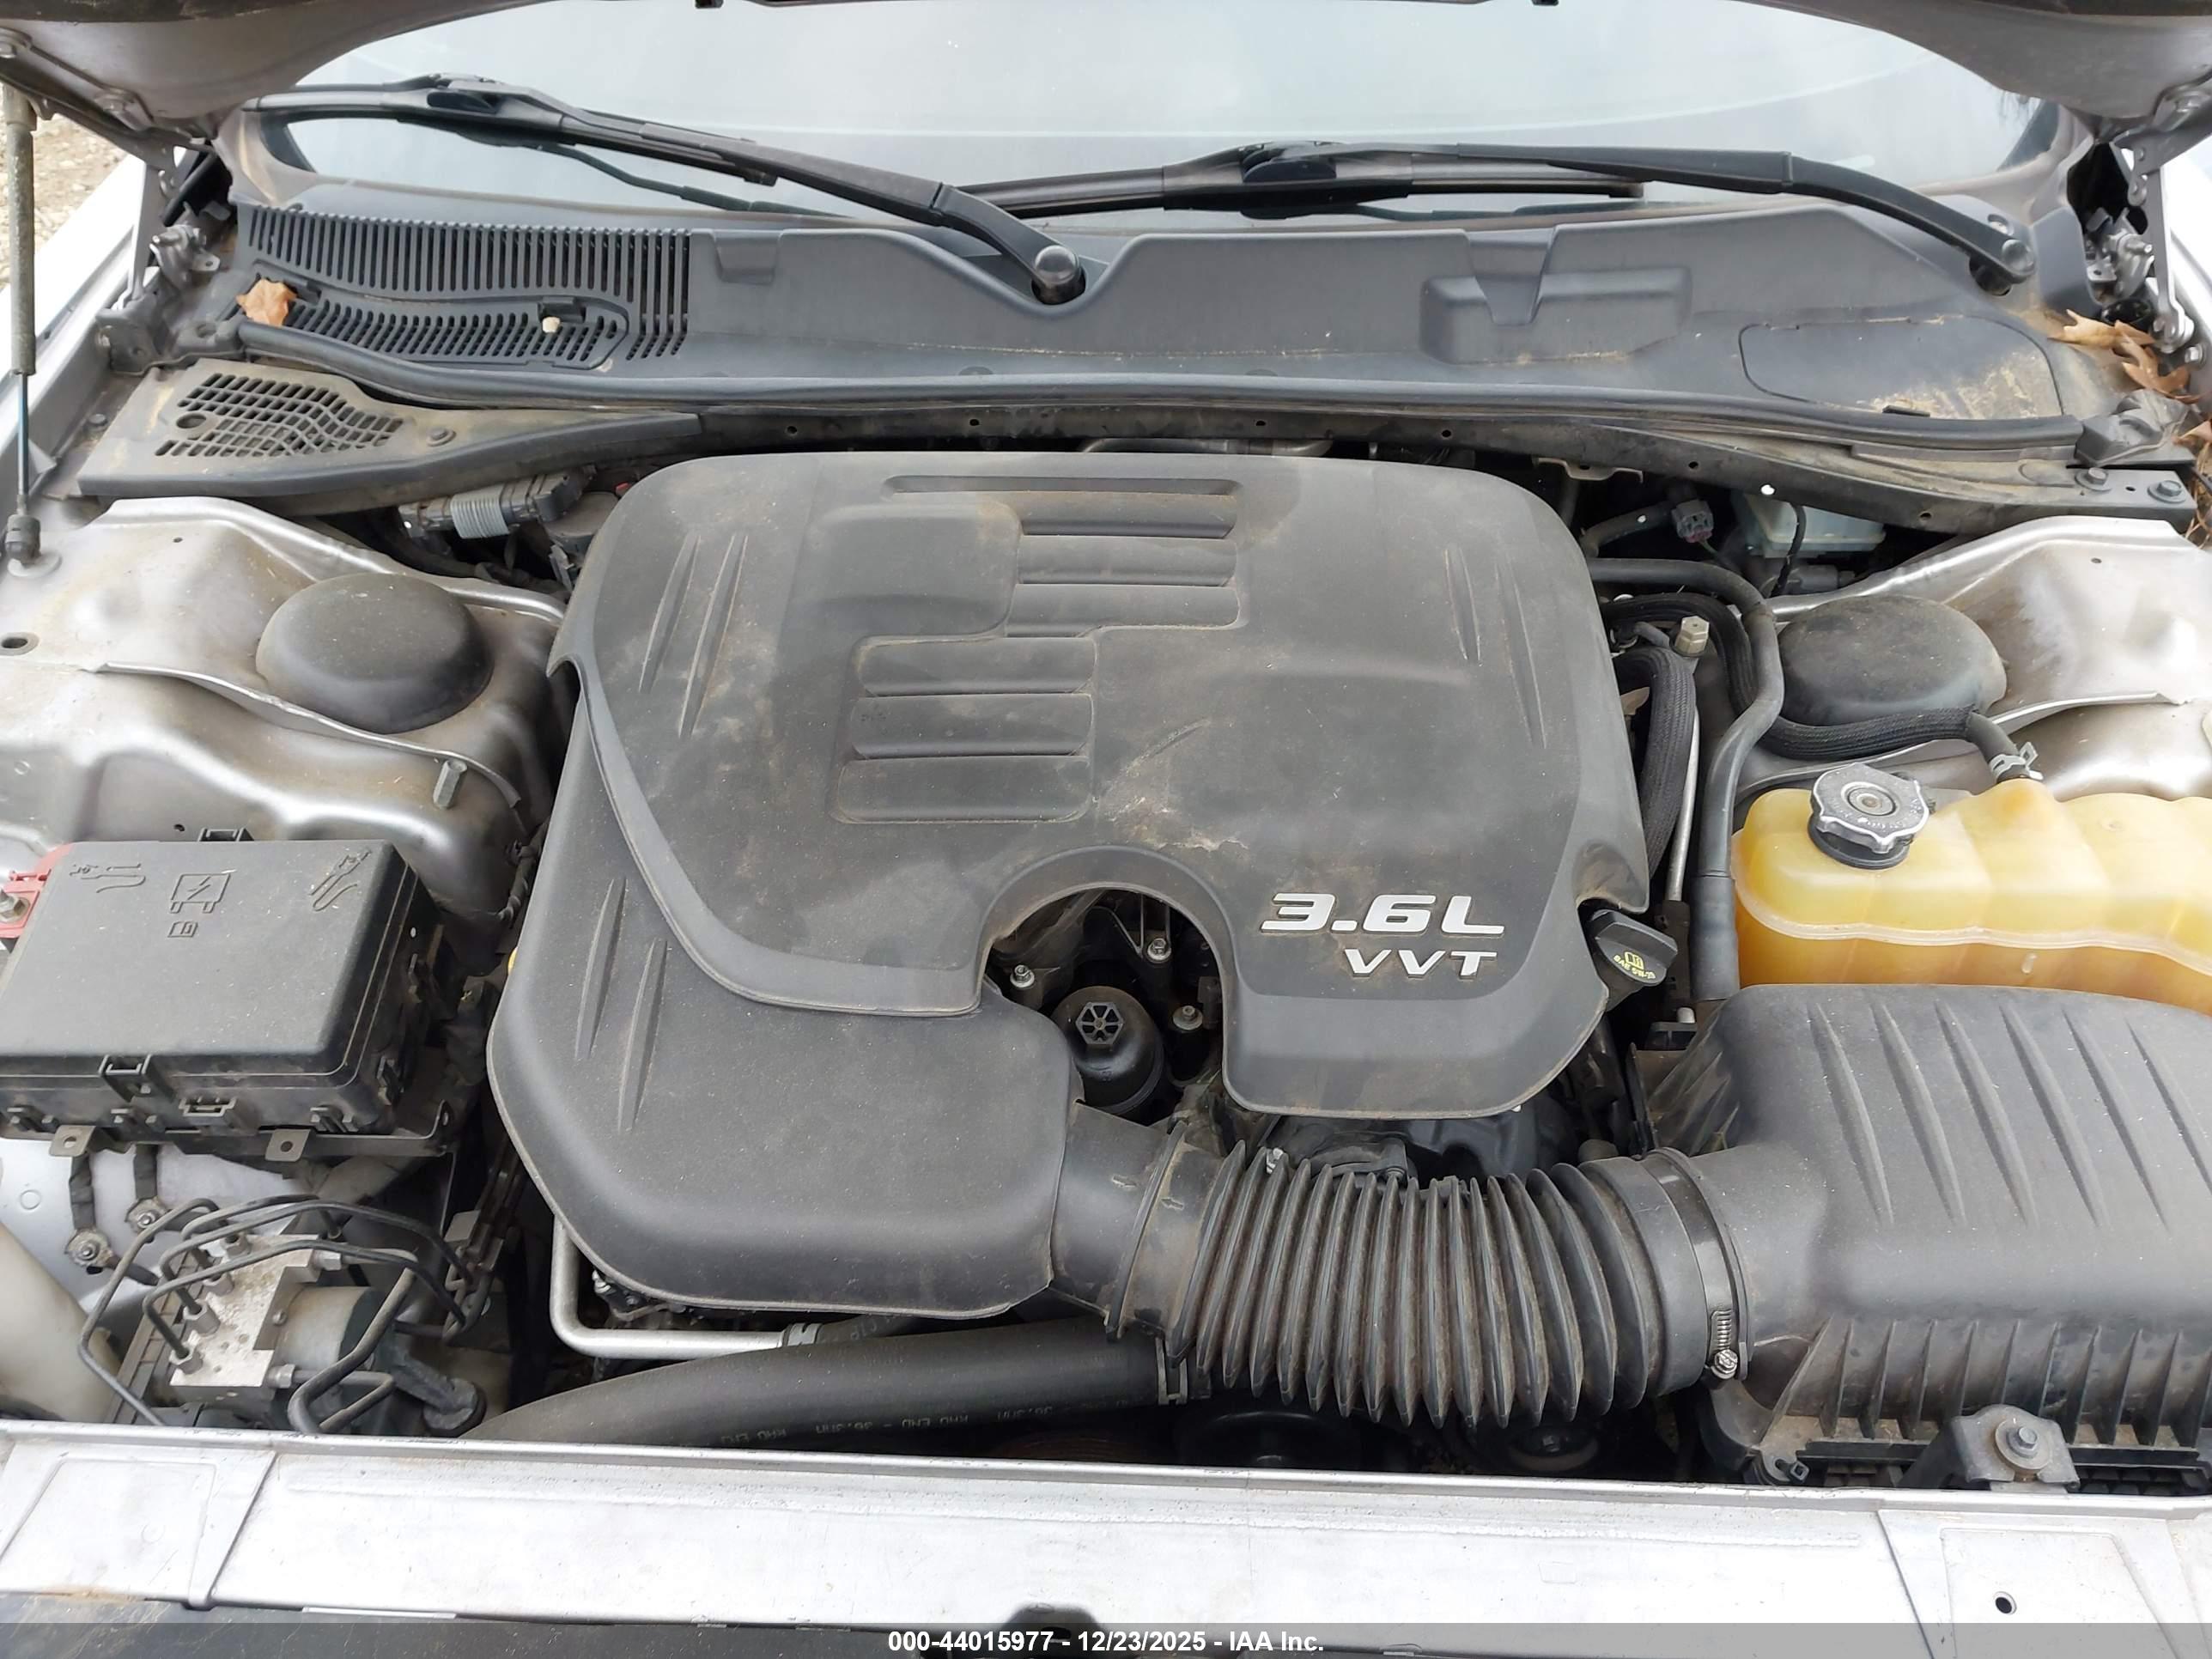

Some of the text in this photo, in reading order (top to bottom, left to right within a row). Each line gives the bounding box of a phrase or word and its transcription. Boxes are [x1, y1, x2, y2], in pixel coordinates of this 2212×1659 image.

[1261, 893, 1504, 935] 3.6L
[1344, 949, 1498, 977] VVT
[1613, 955, 1631, 970] SAE
